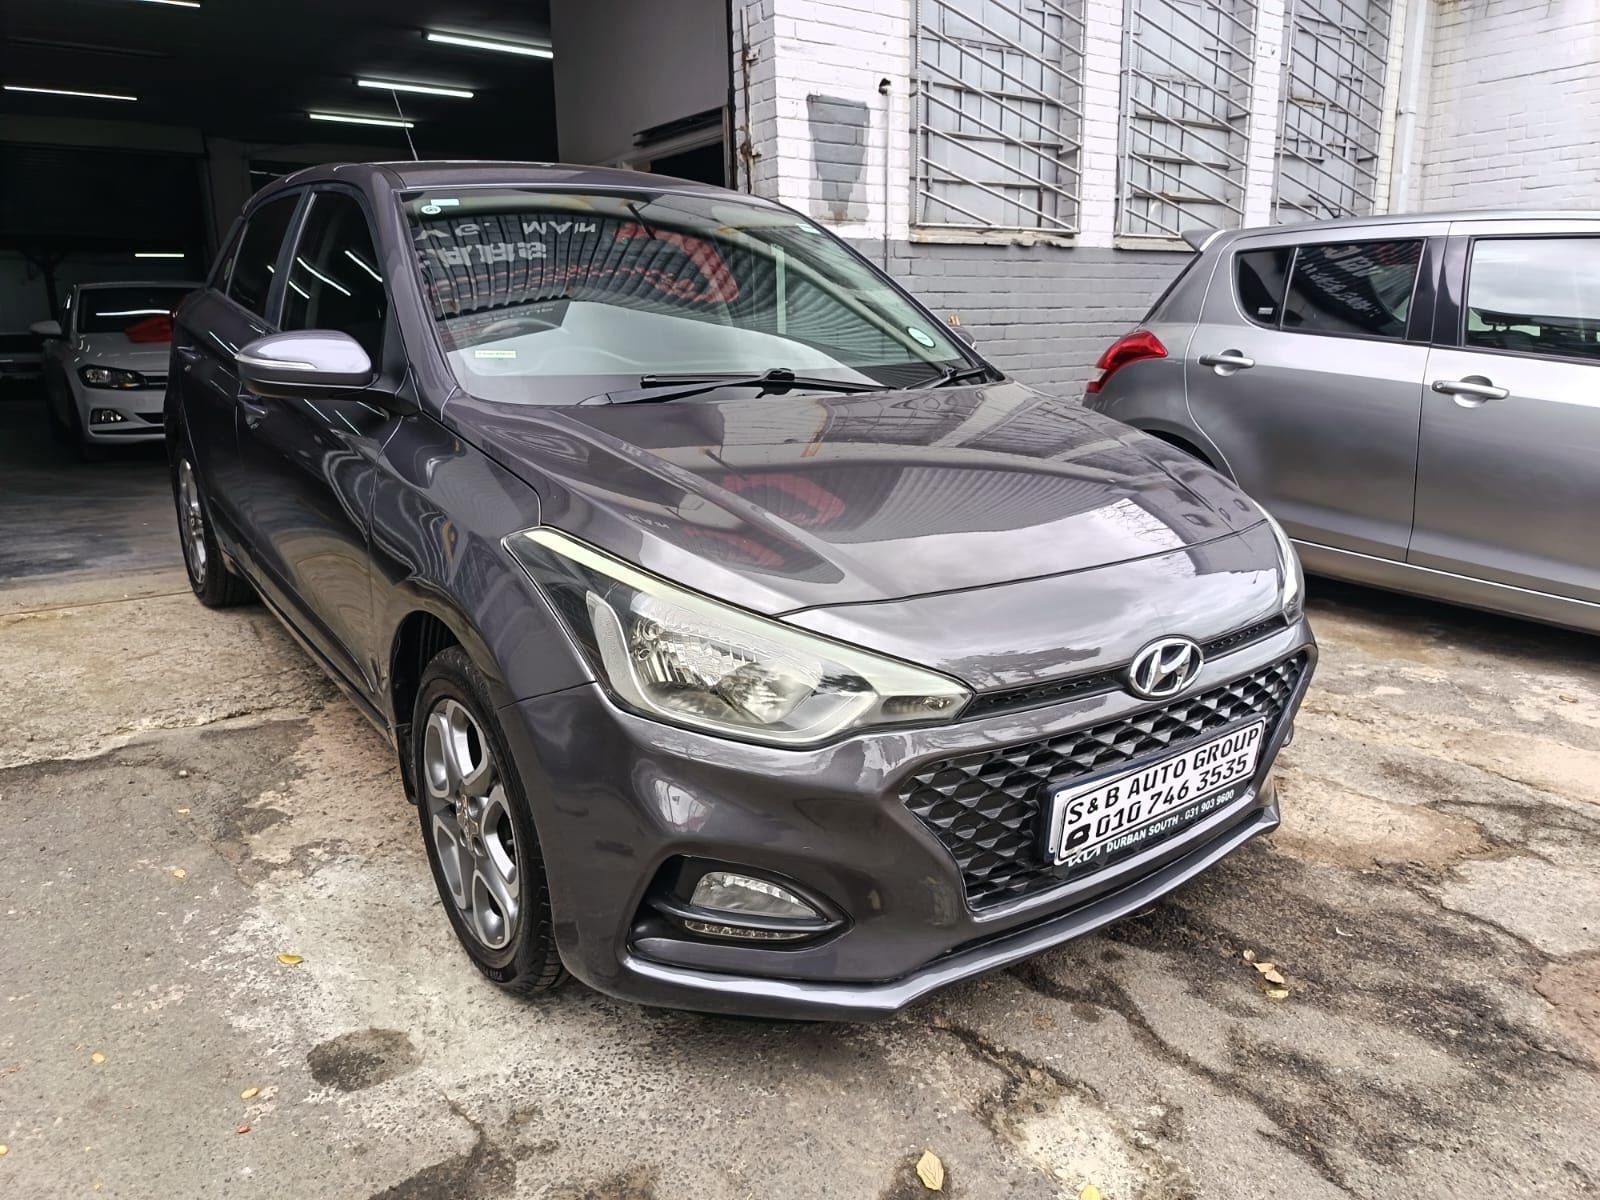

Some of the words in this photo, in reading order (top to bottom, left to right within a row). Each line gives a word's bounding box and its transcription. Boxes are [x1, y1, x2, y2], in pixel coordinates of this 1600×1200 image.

[1096, 801, 1141, 837] 010
[1147, 781, 1189, 814] 746
[1197, 753, 1249, 792] 3535
[1127, 758, 1186, 799] AUTO
[1193, 727, 1259, 771] GROUP
[1106, 828, 1146, 853] DURBAN
[1148, 817, 1179, 836] SOUTH
[1185, 806, 1199, 820] 031
[1201, 798, 1215, 812] 903
